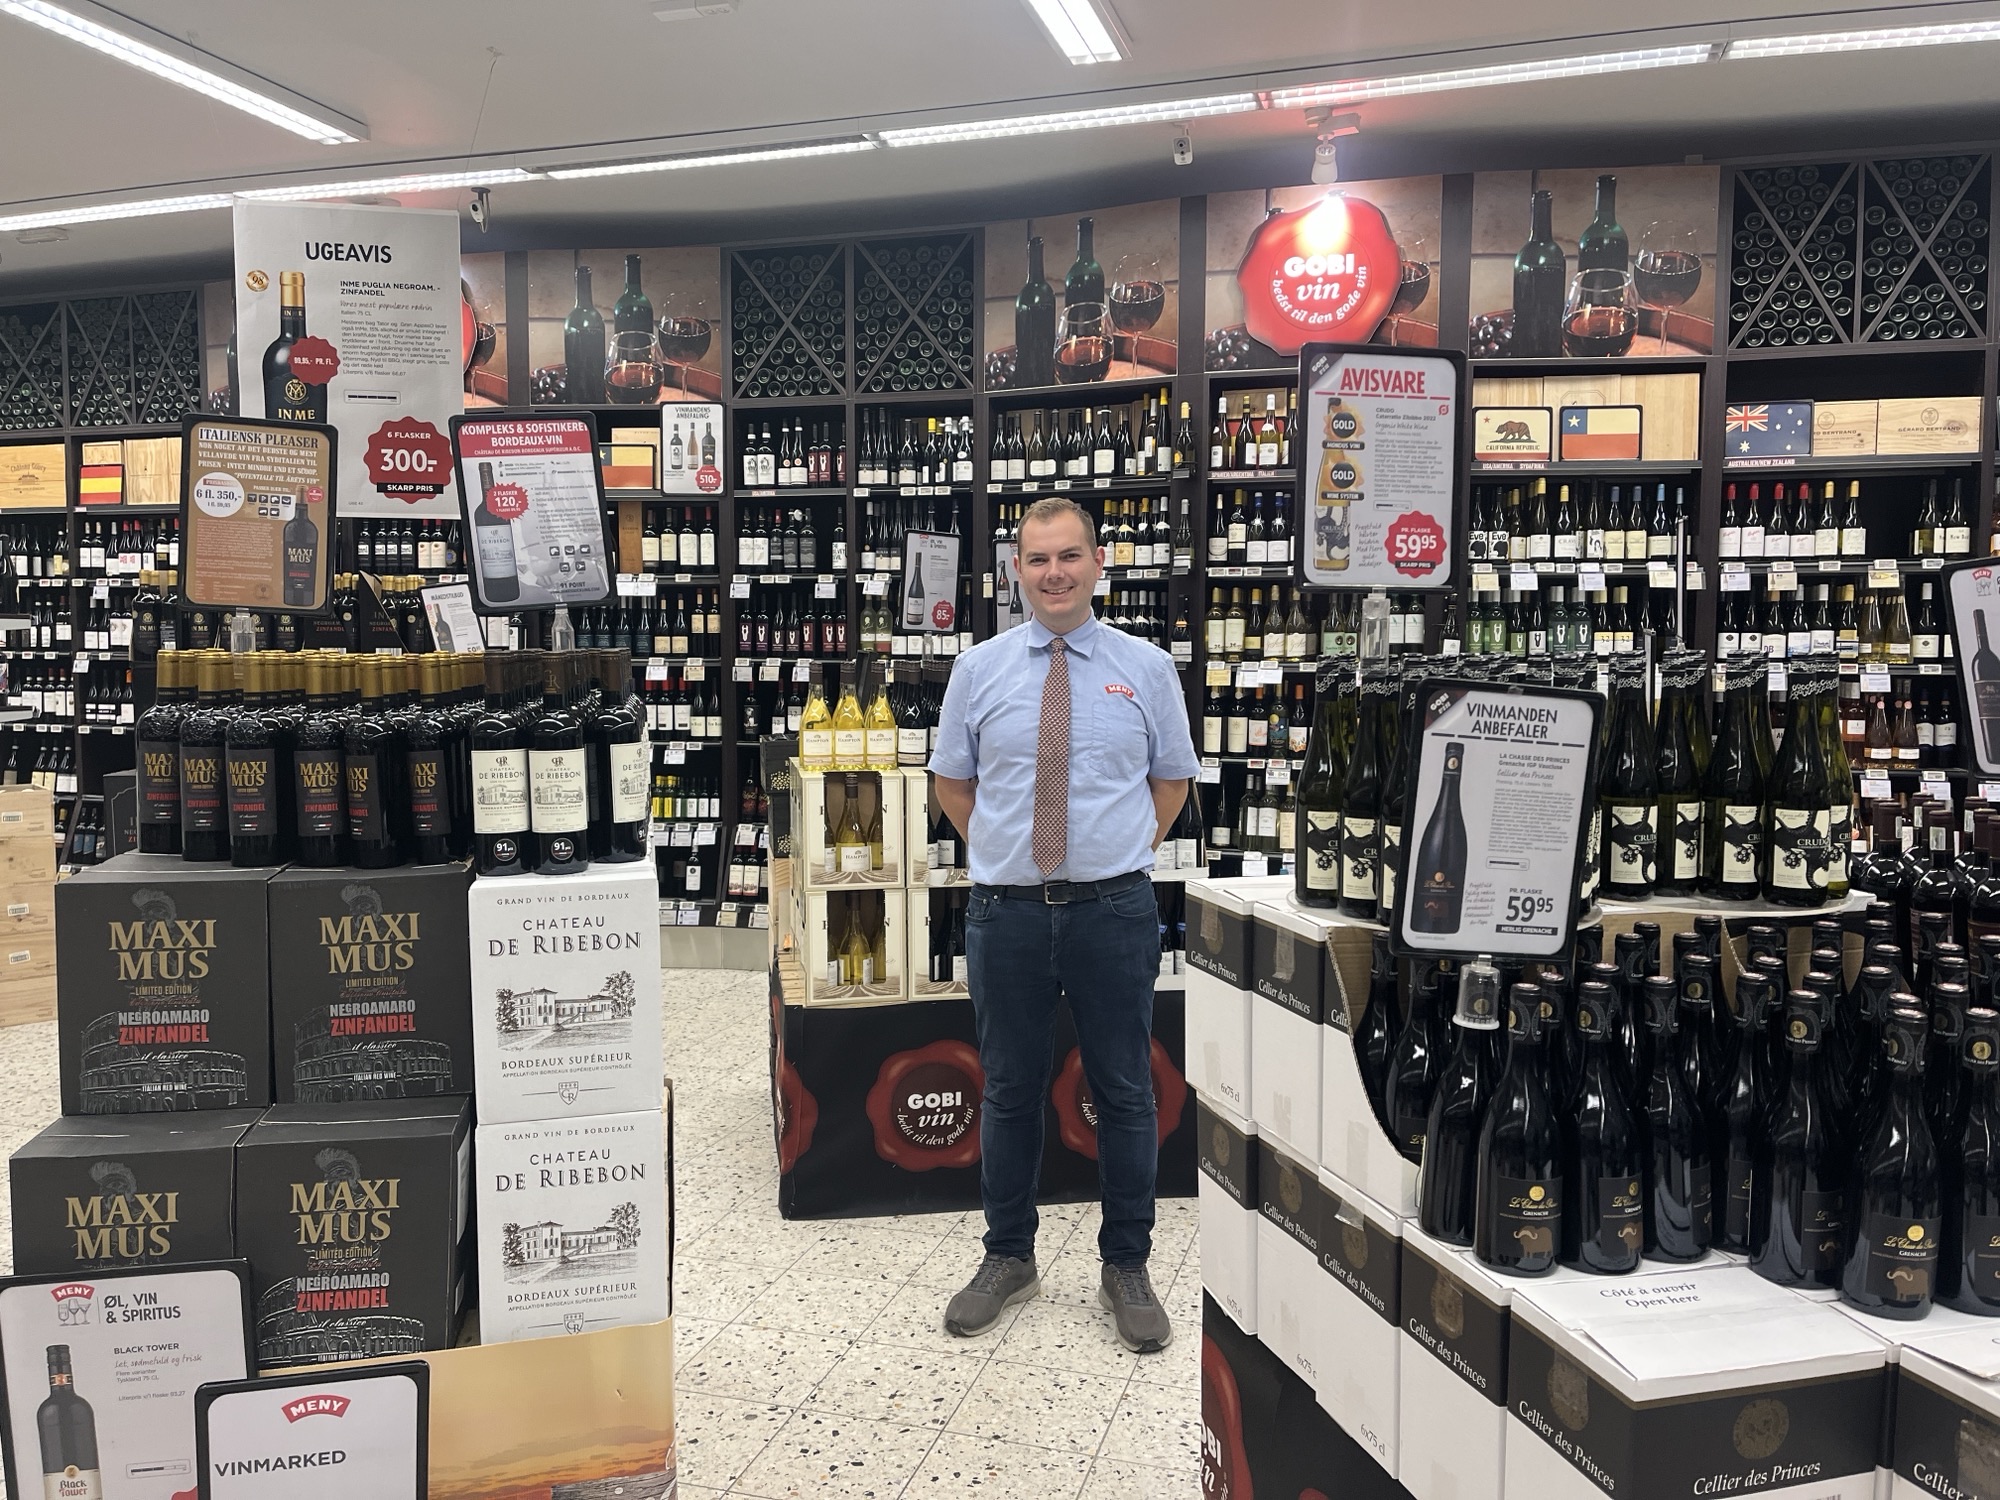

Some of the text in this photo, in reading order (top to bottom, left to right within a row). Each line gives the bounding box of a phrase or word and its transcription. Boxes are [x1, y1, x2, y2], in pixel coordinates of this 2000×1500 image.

[305, 242, 392, 263] UGEAVIS
[1284, 253, 1355, 278] GOBI
[252, 276, 264, 286] 98
[362, 281, 391, 289] PUGLIA
[393, 283, 436, 291] NEGROAM.
[1296, 277, 1341, 301] vin
[1272, 265, 1367, 324] bedst til den gode vin
[1340, 367, 1426, 394] AVISVARE
[461, 423, 515, 436] KOMPLEKS
[516, 424, 524, 434] &
[1333, 420, 1355, 430] GOLD
[199, 428, 319, 448] ITALIENSK PLEASER
[491, 435, 563, 448] BORDEAUX-VIN
[199, 442, 213, 450] NOK
[213, 443, 236, 451] NOGET
[247, 445, 261, 453] DET
[289, 448, 299, 456] OG
[299, 449, 318, 458] MEST
[198, 451, 237, 460] VELLAVEDE
[238, 453, 250, 461] VIN
[251, 454, 265, 462] FRA
[306, 458, 318, 467] TIL
[198, 460, 222, 468] PRISEN
[227, 462, 246, 470] INTET
[247, 463, 273, 472] MINDRE
[273, 465, 287, 473] END
[287, 466, 297, 474] ET
[1728, 459, 1771, 467] AUSTRALIEN/NEW
[1332, 470, 1354, 480] GOLD
[196, 489, 203, 498] 6
[204, 489, 215, 499] fl.
[216, 489, 242, 502] 350,-
[1469, 531, 1484, 540] Eve
[1108, 685, 1132, 696] MENY
[1467, 702, 1558, 724] VINMANDEN
[1471, 719, 1549, 739] ANBEFALER
[1498, 760, 1525, 768] Grenache
[1538, 762, 1563, 770] Vaucluse
[1508, 753, 1532, 761] CHASSE
[1545, 756, 1570, 764] PRINCES
[229, 760, 268, 775] MAXI
[491, 771, 525, 779] RIBEBON
[231, 773, 265, 787] MUS
[319, 912, 421, 946] MAXI
[522, 915, 605, 931] CHATEAU
[1522, 927, 1553, 935] GRENACHE
[108, 919, 217, 951] MAXI
[488, 931, 642, 957] DE RIBEBON
[117, 949, 210, 981] MUS
[327, 941, 415, 974] MUS
[135, 984, 192, 996] LIMITED EDITION
[118, 1008, 210, 1026] NEGROAMARO
[330, 1014, 416, 1037] ZINFANDEL
[118, 1024, 210, 1045] ZINFANDEL
[140, 1051, 189, 1061] il classico
[501, 1051, 633, 1070] BORDEAUX SUPÉRIEUR
[353, 1071, 397, 1082] ITALIAN RED WINE
[569, 1065, 600, 1073] SUPÉRIEUR
[907, 1091, 962, 1110] GOBI
[896, 1105, 975, 1146] bedst til den gode vin
[917, 1107, 956, 1128] vin
[504, 1132, 539, 1141] GRAND
[584, 1125, 635, 1135] BORDEAUX
[529, 1148, 611, 1165] CHATEAU
[495, 1163, 647, 1192] DE RIBEBON
[289, 1178, 401, 1214] MAXI
[65, 1191, 180, 1228] MAXI
[297, 1210, 392, 1245] MUS
[74, 1224, 172, 1260] MUS
[55, 1286, 92, 1300] MENY
[1599, 1282, 1697, 1299] Côté à ouvrir
[103, 1292, 158, 1310] ØL, VIN
[296, 1289, 389, 1313] ZINFANDEL
[1625, 1293, 1701, 1309] Open here
[105, 1305, 181, 1324] & SPIRITUS
[113, 1342, 180, 1355] BLACK TOWER
[1409, 1317, 1487, 1389] Cellier des Princes
[130, 1356, 170, 1368] sødmefuld
[171, 1357, 181, 1366] og
[290, 1397, 344, 1417] MENY
[1519, 1400, 1615, 1491] Cellier des Princes
[215, 1450, 347, 1478] VINMARKED
[59, 1478, 87, 1489] Black
[1693, 1460, 1821, 1496] Cellier des Princes
[58, 1487, 88, 1498] Tower
